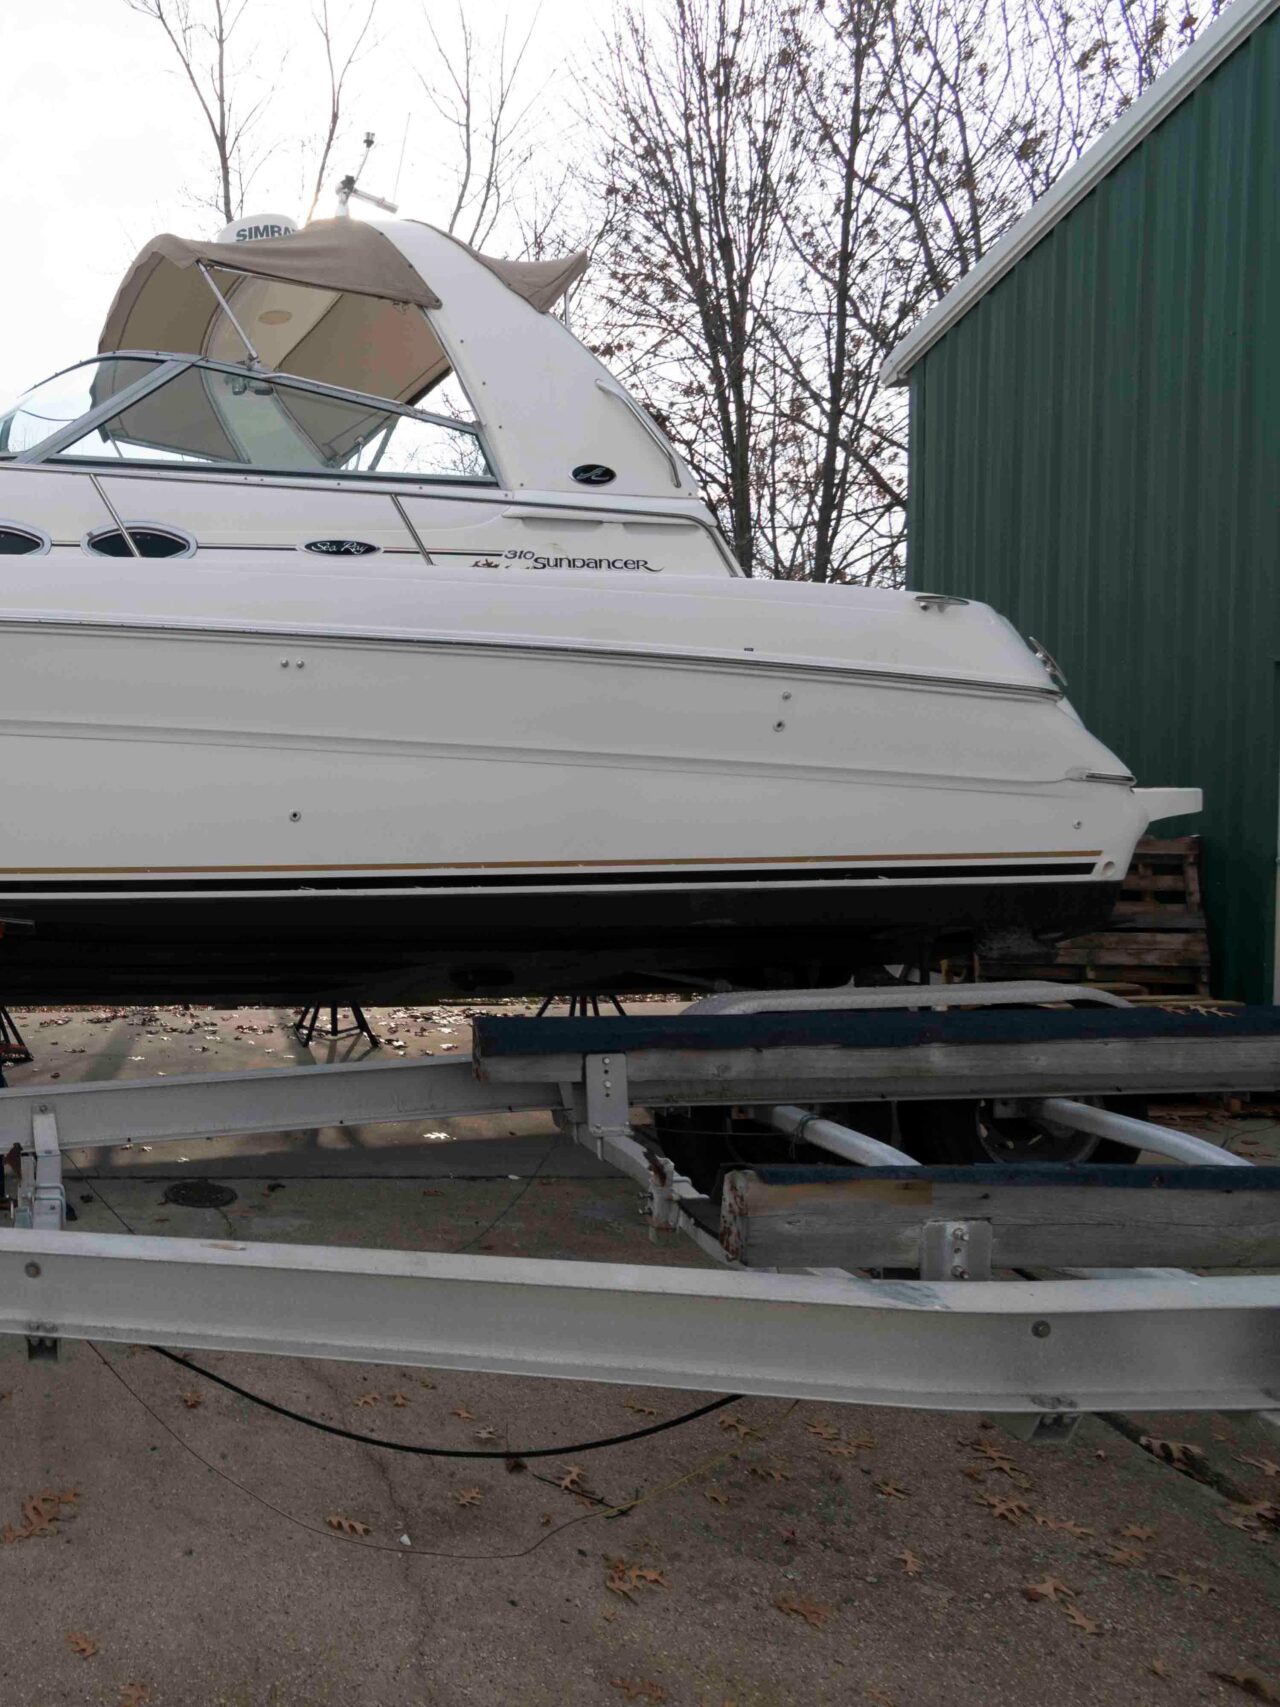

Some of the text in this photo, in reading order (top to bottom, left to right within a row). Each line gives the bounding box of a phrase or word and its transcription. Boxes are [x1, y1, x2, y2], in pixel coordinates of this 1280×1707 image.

[235, 224, 297, 242] SIMRA
[311, 541, 369, 555] Sea Ray
[504, 549, 535, 560] 310
